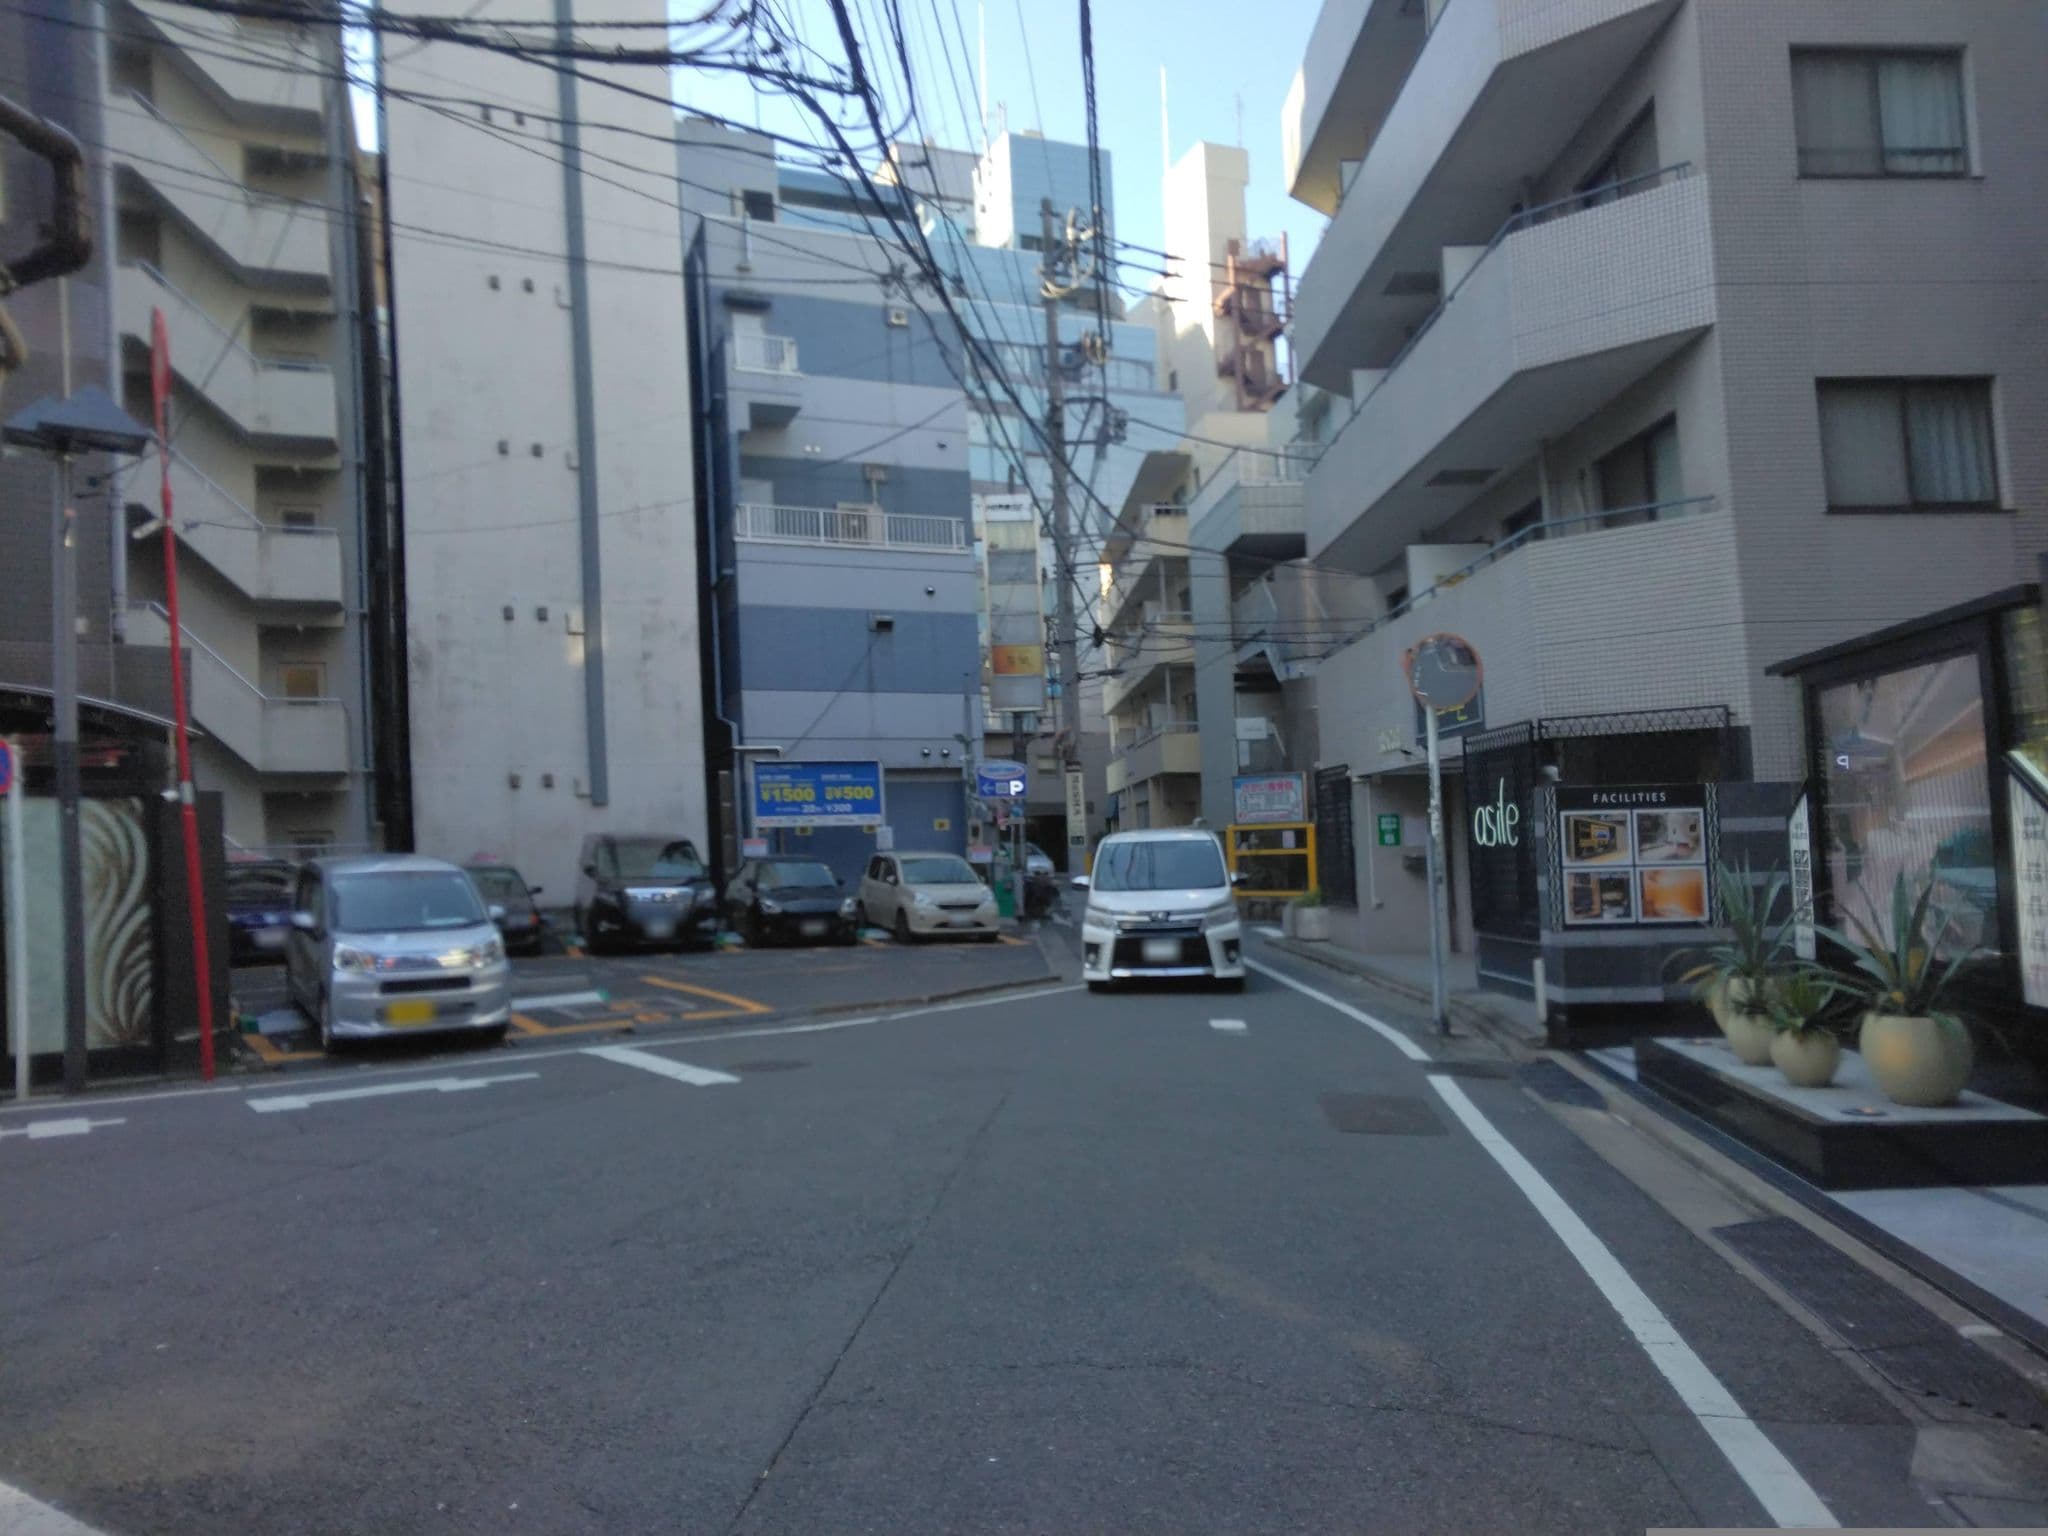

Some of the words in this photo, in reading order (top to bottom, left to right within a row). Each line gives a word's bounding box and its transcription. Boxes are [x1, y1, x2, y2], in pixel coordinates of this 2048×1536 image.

[1010, 780, 1024, 796] P
[1592, 792, 1666, 804] FACILITIES
[1474, 777, 1519, 846] asile
